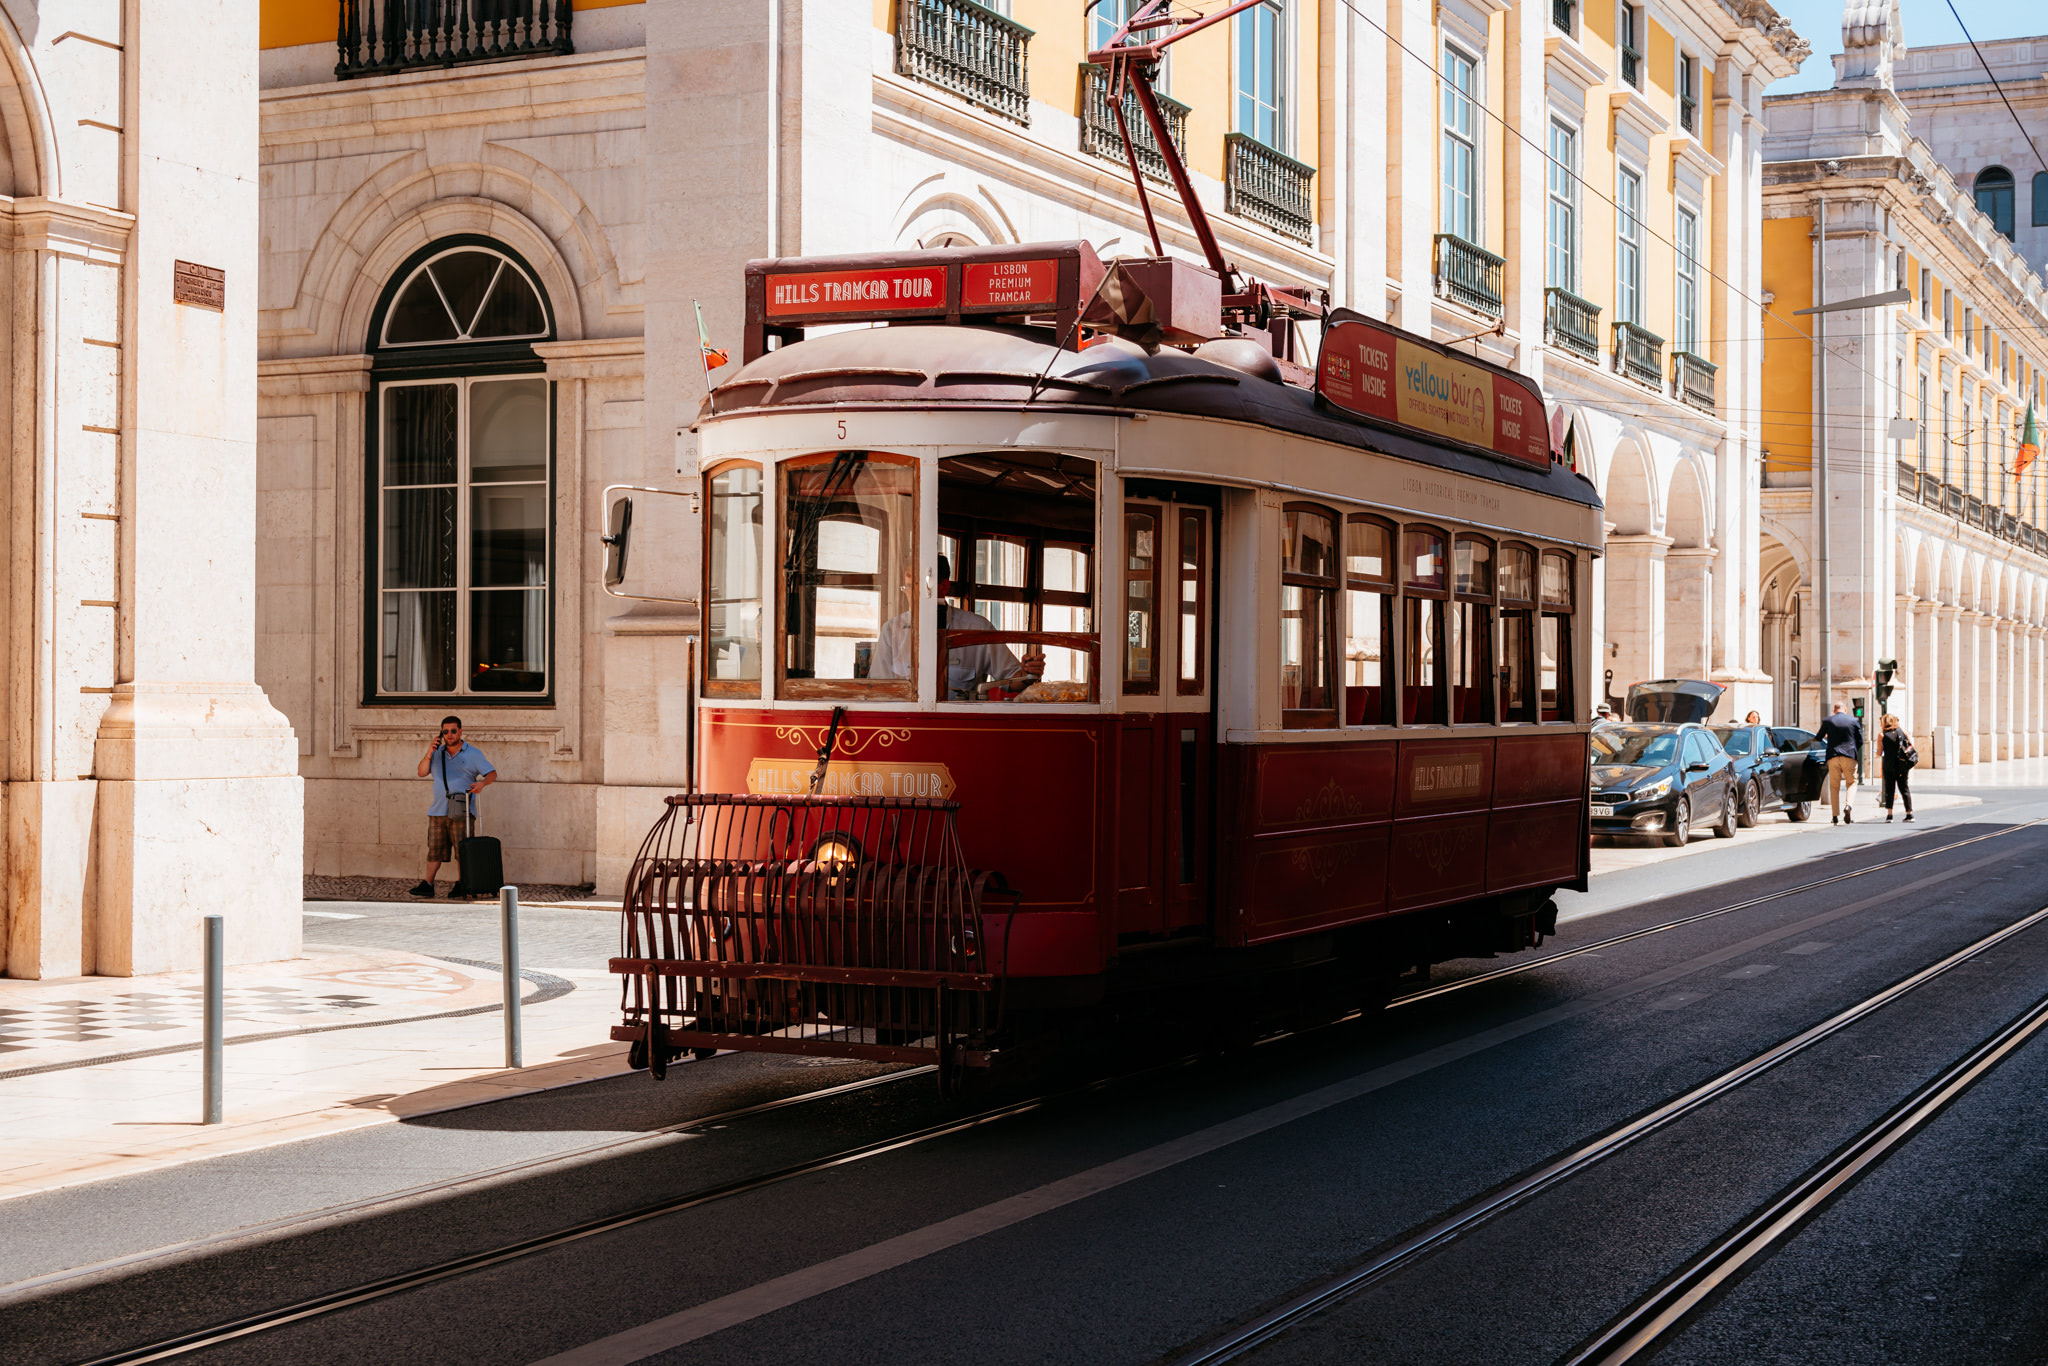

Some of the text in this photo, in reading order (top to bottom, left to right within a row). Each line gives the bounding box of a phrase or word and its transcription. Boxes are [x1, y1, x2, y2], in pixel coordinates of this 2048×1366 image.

[989, 276, 1032, 289] PREMIUM
[993, 264, 1028, 276] LISBON
[775, 278, 933, 305] HILLS TRAMCAR TOUR
[989, 290, 1031, 303] TRAMCAR
[1358, 344, 1389, 371] TICKETS
[1362, 373, 1387, 398] INSIDE
[1451, 372, 1471, 408] bus
[1500, 393, 1523, 417] TICKETS
[837, 420, 847, 440] 5
[1502, 418, 1521, 440] INSIDE
[1402, 478, 1500, 511] LISBON HISTORICAL PREMIUM TRAMCAR
[758, 768, 942, 797] HILLS AMCAR TOUR
[1414, 764, 1480, 791] HILLS TRAMCAR TOUR
